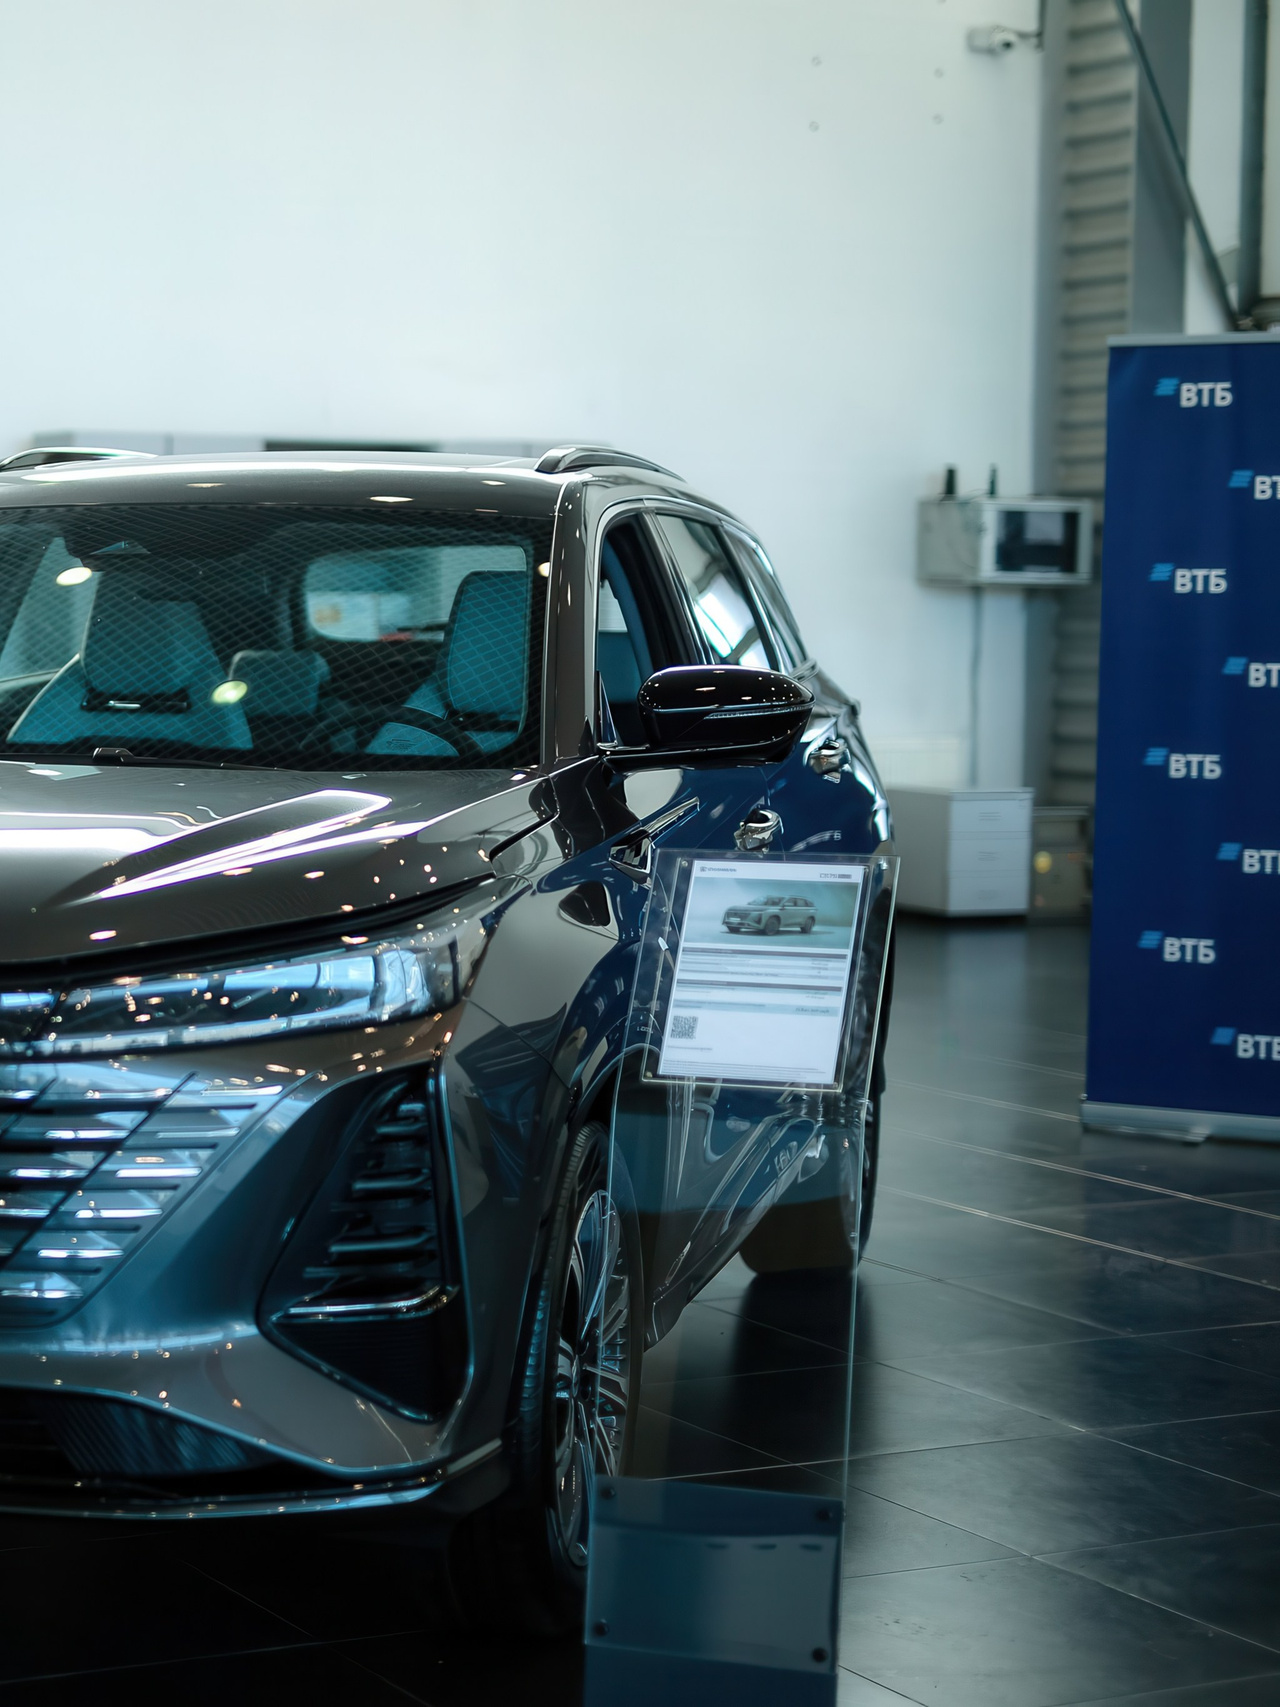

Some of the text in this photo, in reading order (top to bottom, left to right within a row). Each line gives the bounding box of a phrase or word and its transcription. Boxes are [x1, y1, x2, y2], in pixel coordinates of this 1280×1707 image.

[1180, 381, 1232, 407] ВТБ
[1174, 568, 1227, 593] ВТБ
[1169, 753, 1222, 779] ВТБ
[1242, 849, 1280, 875] ВТ
[1163, 937, 1216, 964] ВТБ
